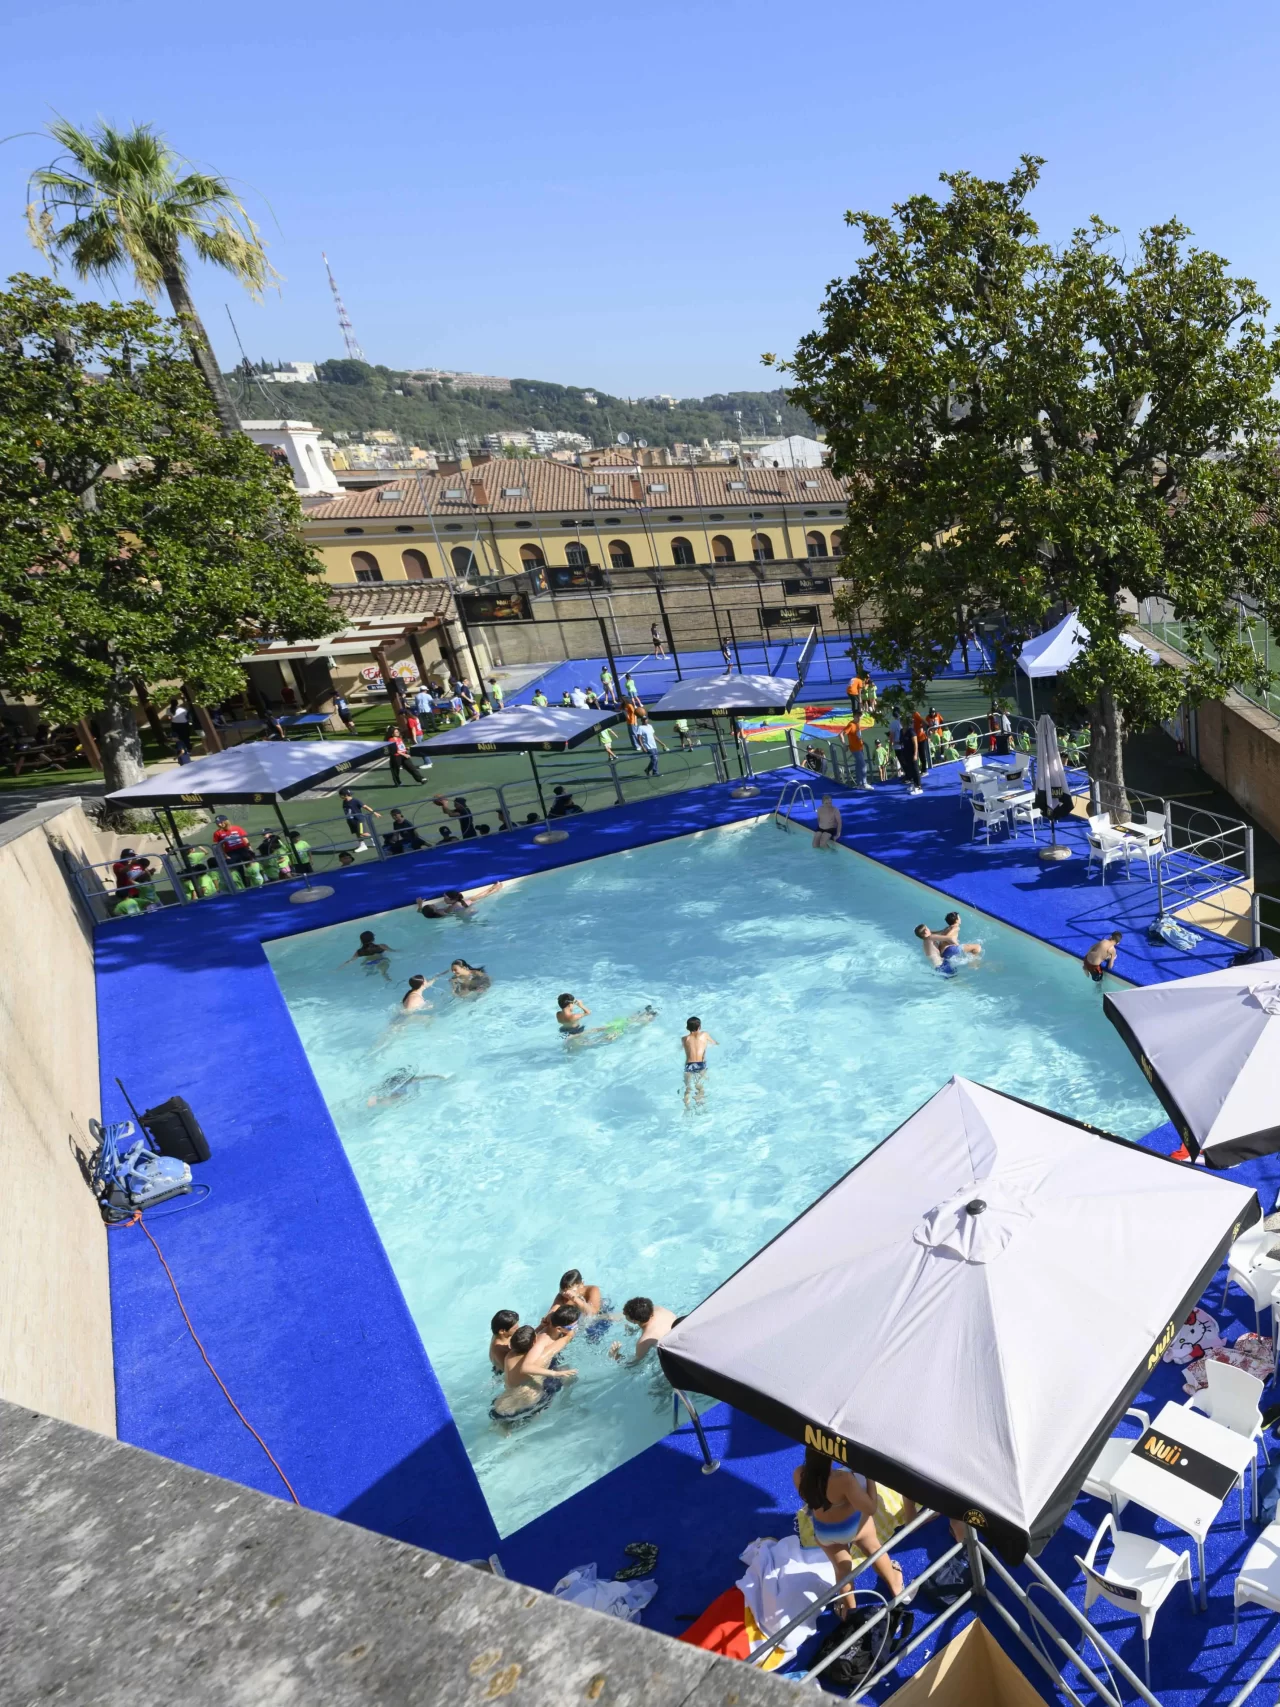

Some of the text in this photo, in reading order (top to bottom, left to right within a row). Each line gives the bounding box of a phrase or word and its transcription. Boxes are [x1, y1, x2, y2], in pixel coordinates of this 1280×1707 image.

[1147, 1320, 1175, 1371] Nuii
[804, 1424, 848, 1463] Nuii
[1144, 1436, 1182, 1465] Nuii
